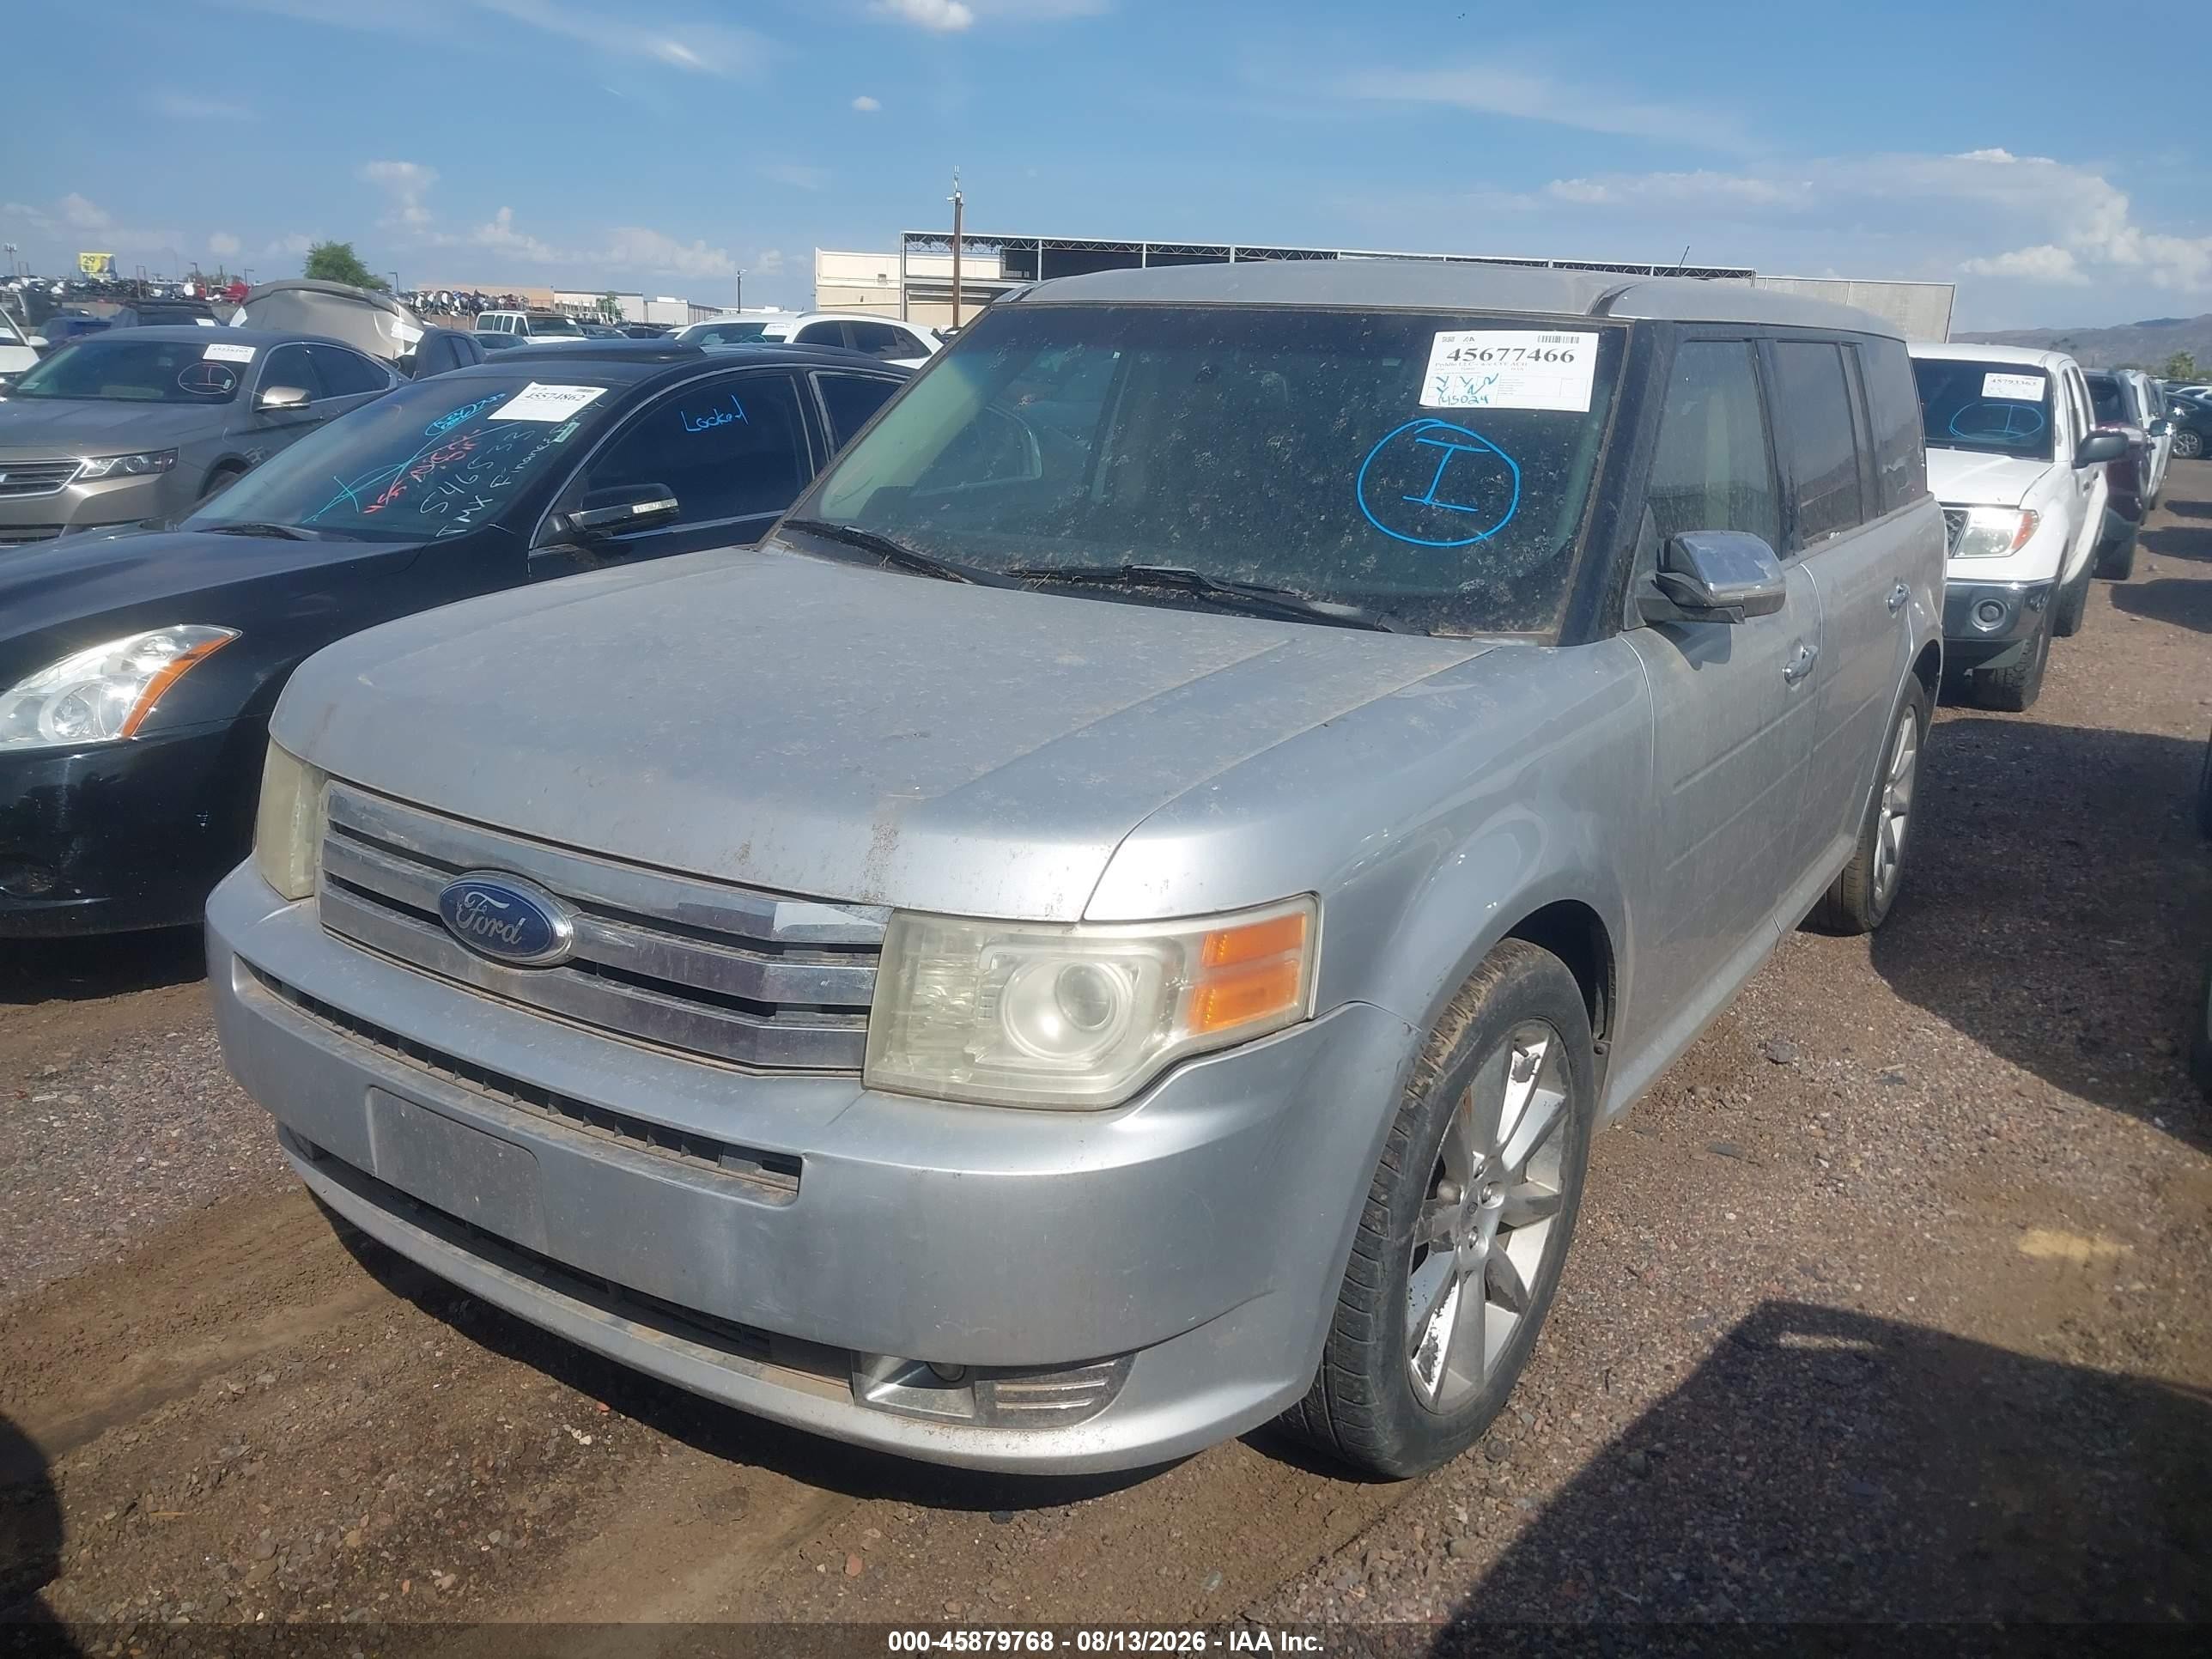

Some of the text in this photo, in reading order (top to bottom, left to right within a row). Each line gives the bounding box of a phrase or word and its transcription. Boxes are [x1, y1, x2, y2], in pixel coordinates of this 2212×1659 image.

[1446, 347, 1576, 363] 45677466
[681, 394, 748, 432] Locked
[456, 891, 526, 945] Ford
